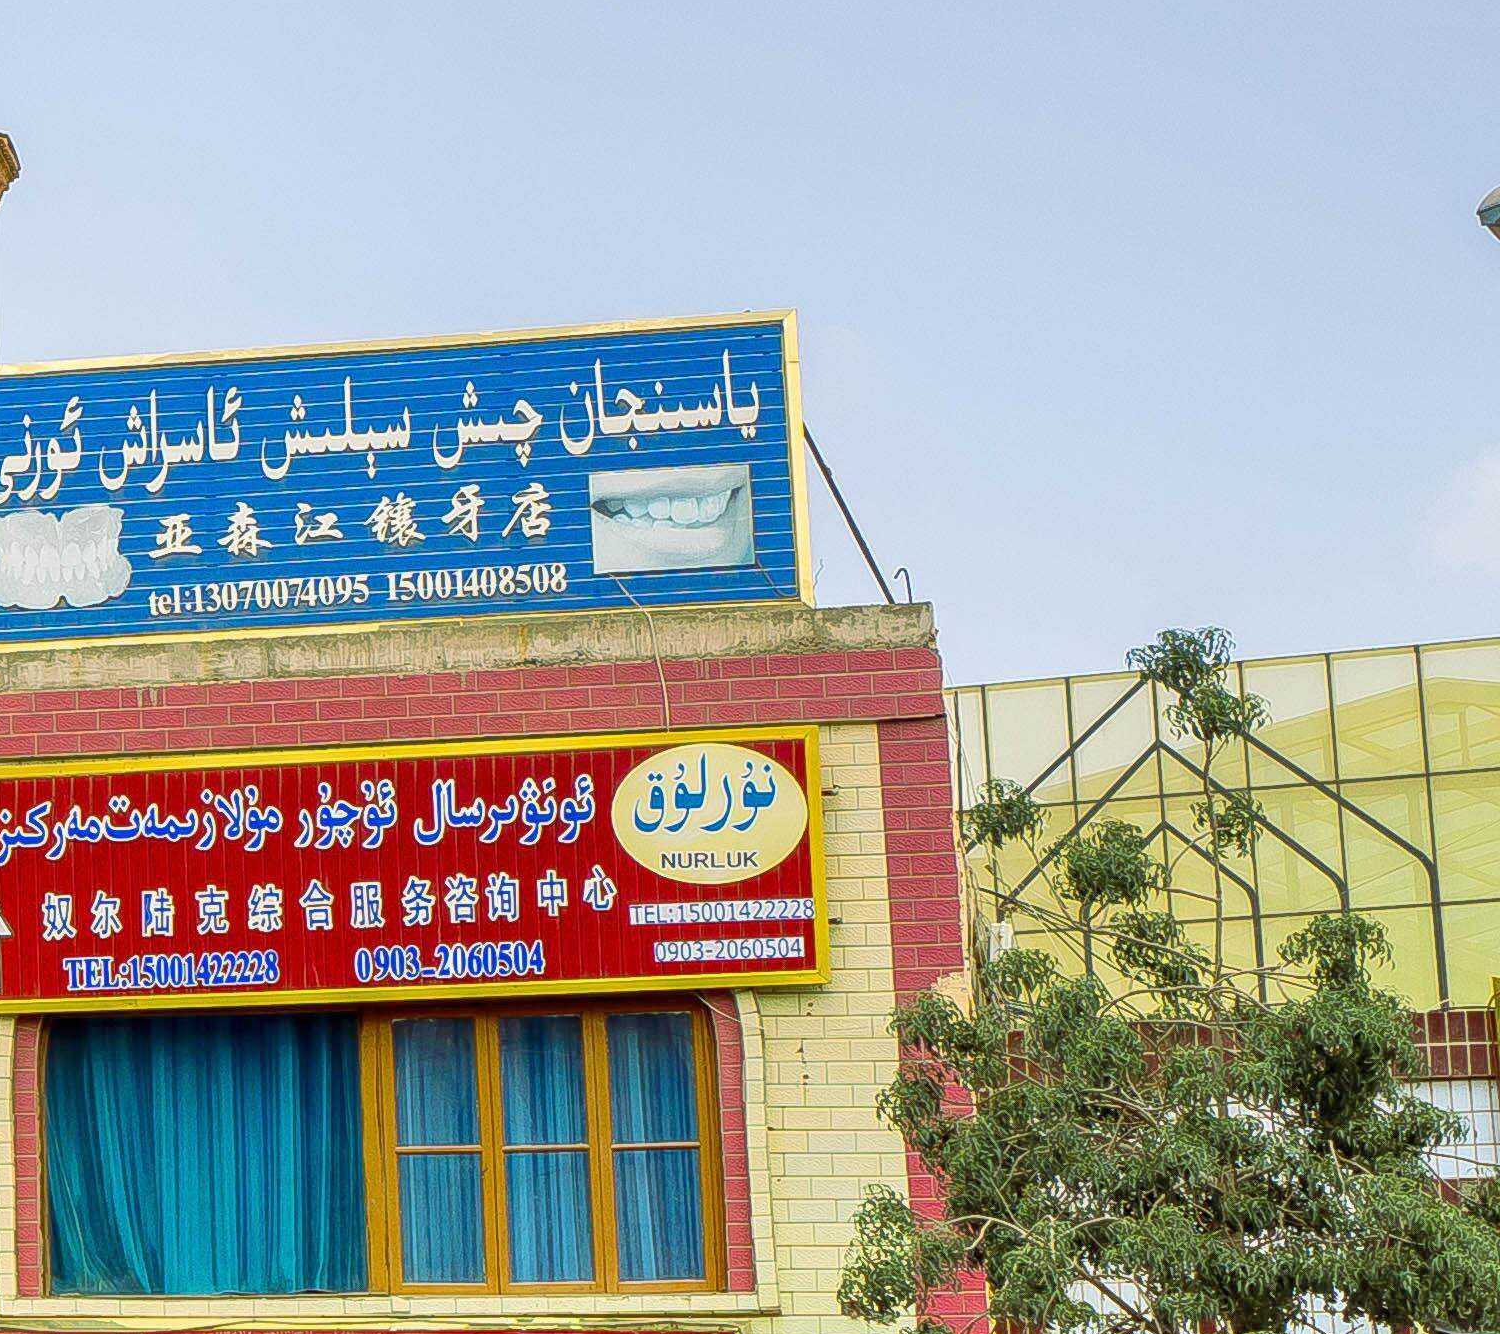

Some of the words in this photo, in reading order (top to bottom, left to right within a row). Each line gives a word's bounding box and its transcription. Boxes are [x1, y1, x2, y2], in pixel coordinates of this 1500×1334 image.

[148, 483, 553, 559] 亚森江镶牙店
[148, 575, 370, 617] tel:13070074095
[385, 563, 567, 601] 15001408508
[660, 851, 759, 869] NURLUK
[42, 864, 618, 940] 奴尔陆克综合服务咨询中心
[632, 899, 814, 924] TEL:15001422228
[63, 949, 280, 991] TEL:15001422228
[655, 938, 802, 962] 0903-2060504
